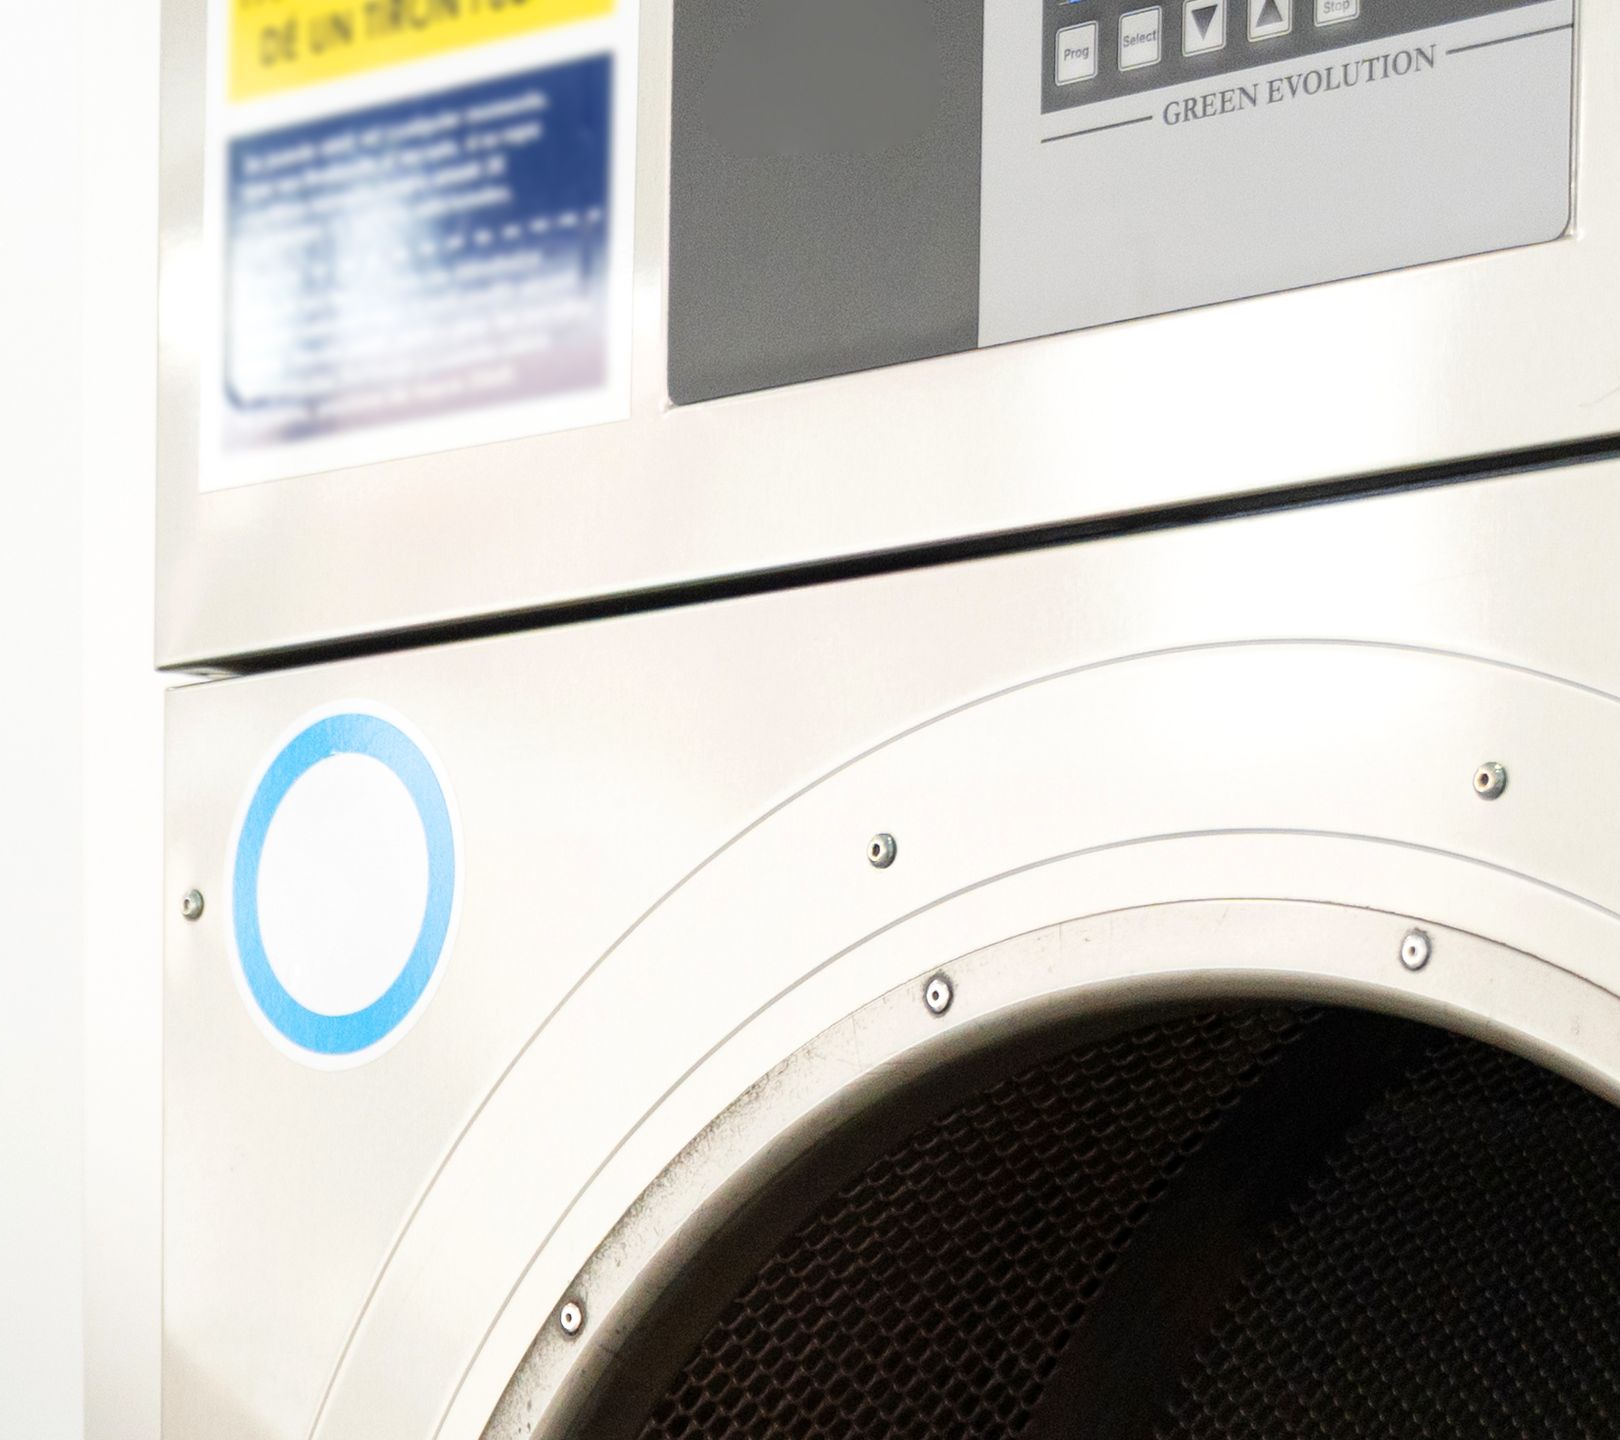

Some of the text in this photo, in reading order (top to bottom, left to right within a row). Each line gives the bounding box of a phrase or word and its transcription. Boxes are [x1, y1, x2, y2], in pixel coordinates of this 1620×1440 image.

[1323, 0, 1350, 14] Stop
[1123, 30, 1157, 48] Select
[1064, 47, 1089, 60] Prog
[1163, 44, 1437, 126] GREEN EVOLUTION
